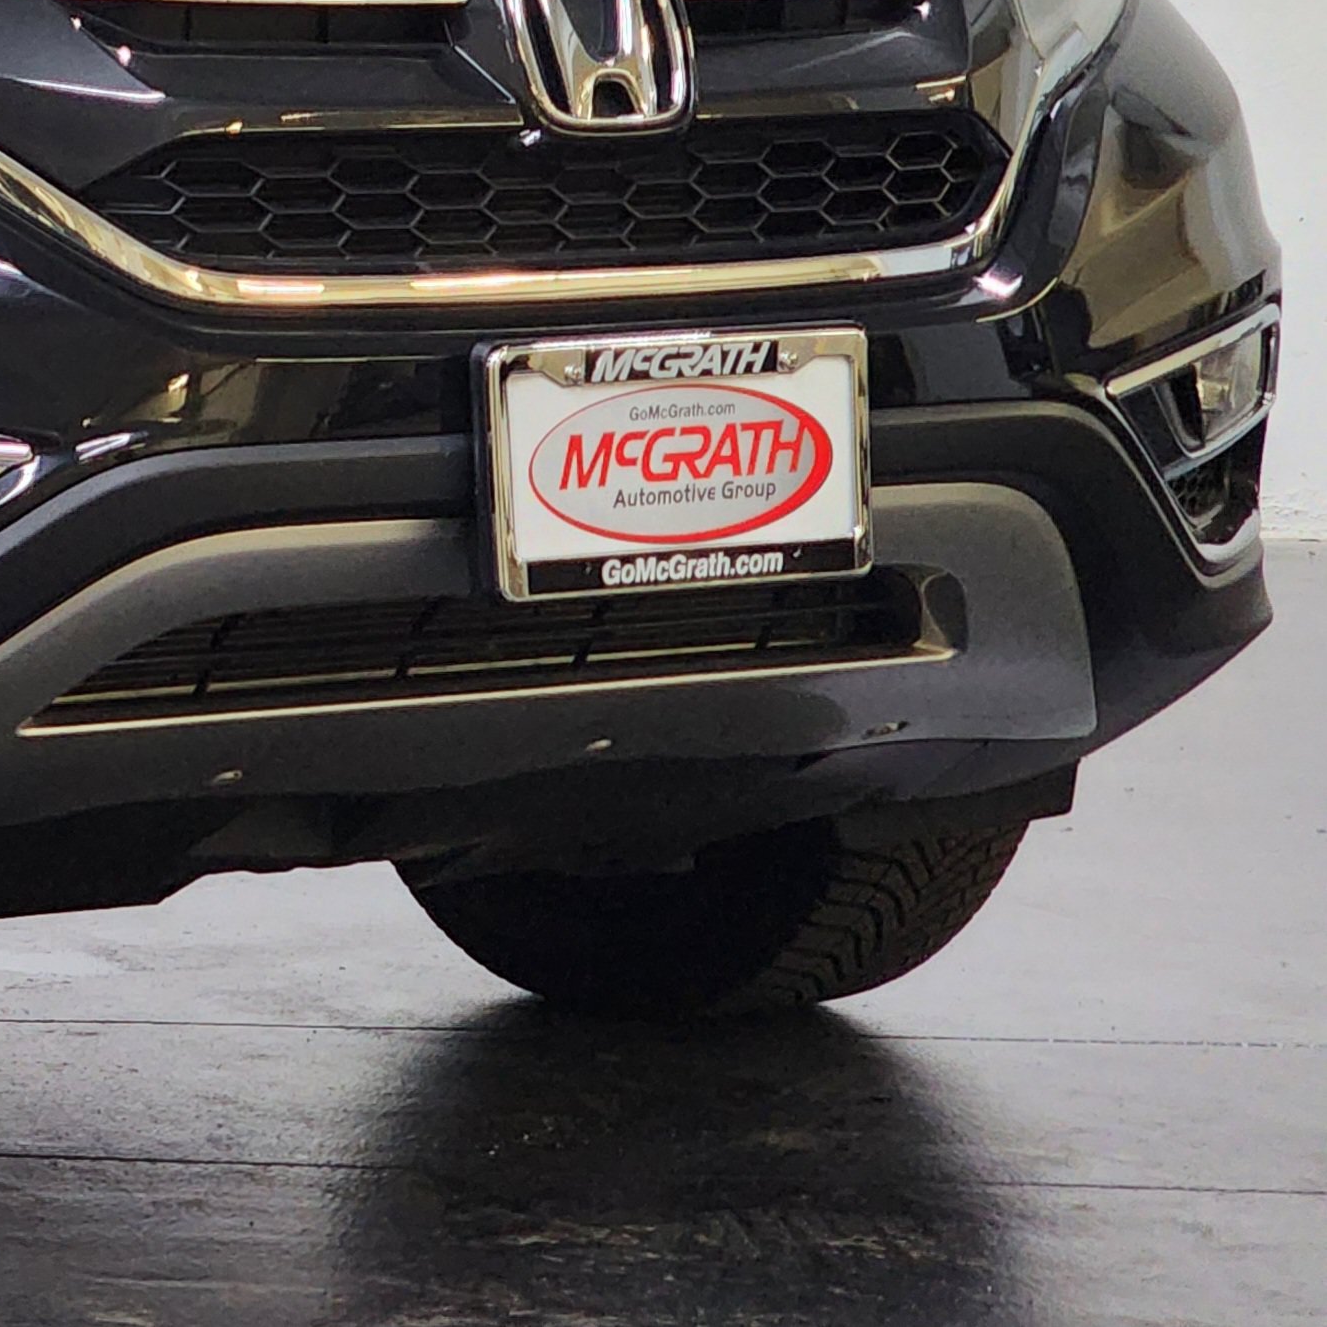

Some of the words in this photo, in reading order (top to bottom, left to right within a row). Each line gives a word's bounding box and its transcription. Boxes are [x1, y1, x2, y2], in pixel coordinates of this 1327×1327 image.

[629, 402, 736, 422] GoMcGrath.com
[613, 485, 716, 509] Automotive
[721, 482, 777, 502] Group
[602, 550, 784, 586] GoMcGrath.com
